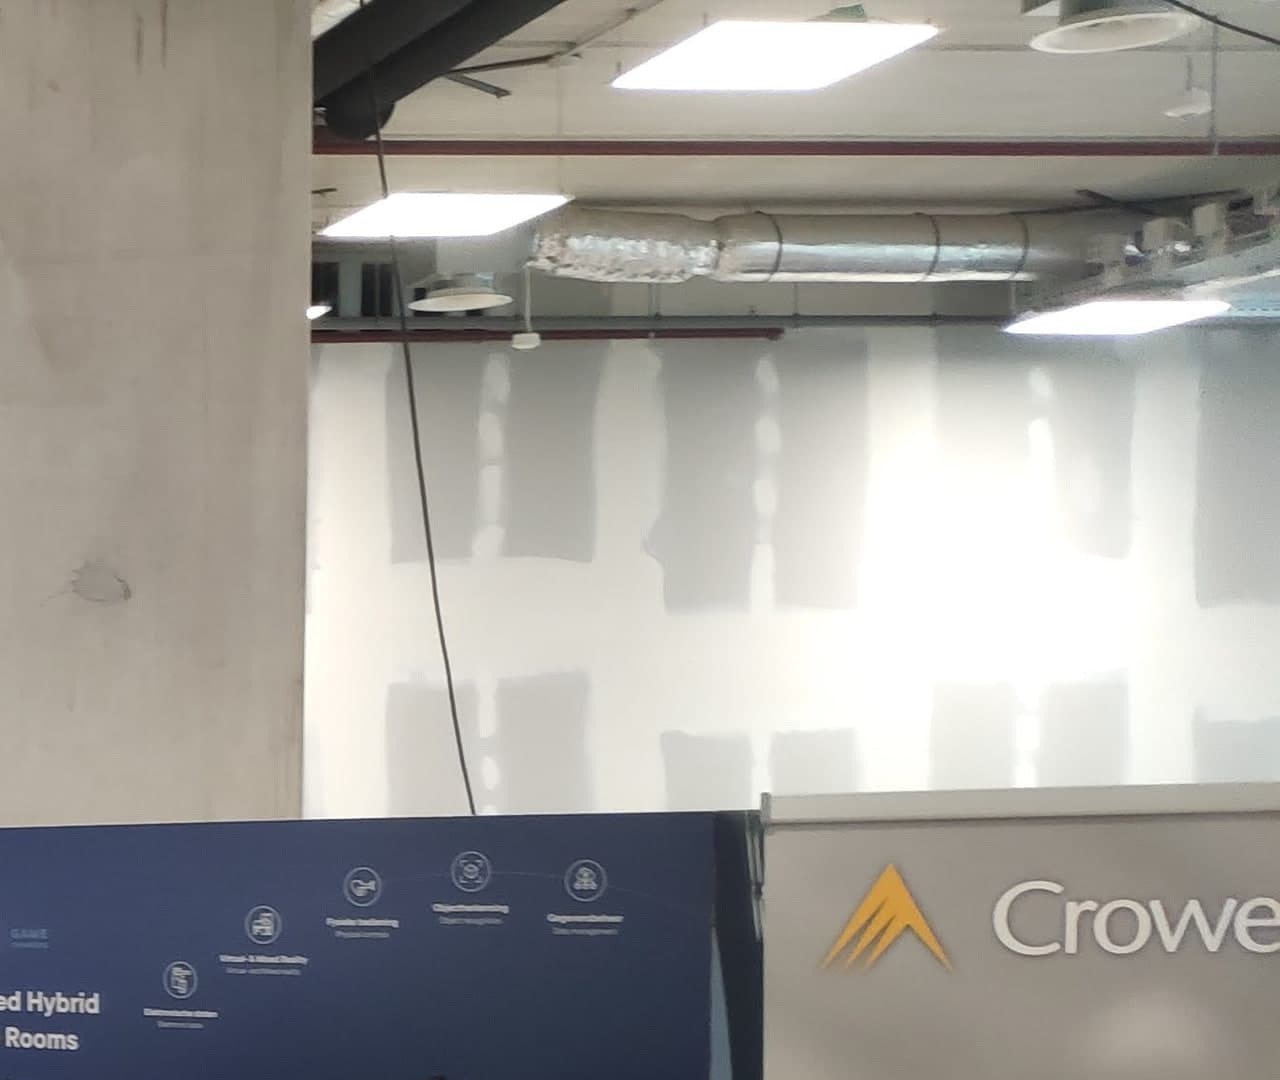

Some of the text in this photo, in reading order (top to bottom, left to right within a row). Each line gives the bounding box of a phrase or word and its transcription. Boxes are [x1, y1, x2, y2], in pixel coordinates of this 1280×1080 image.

[993, 880, 1280, 956] Crowe
[27, 990, 100, 1017] Hybrid
[5, 1026, 79, 1050] Rooms
